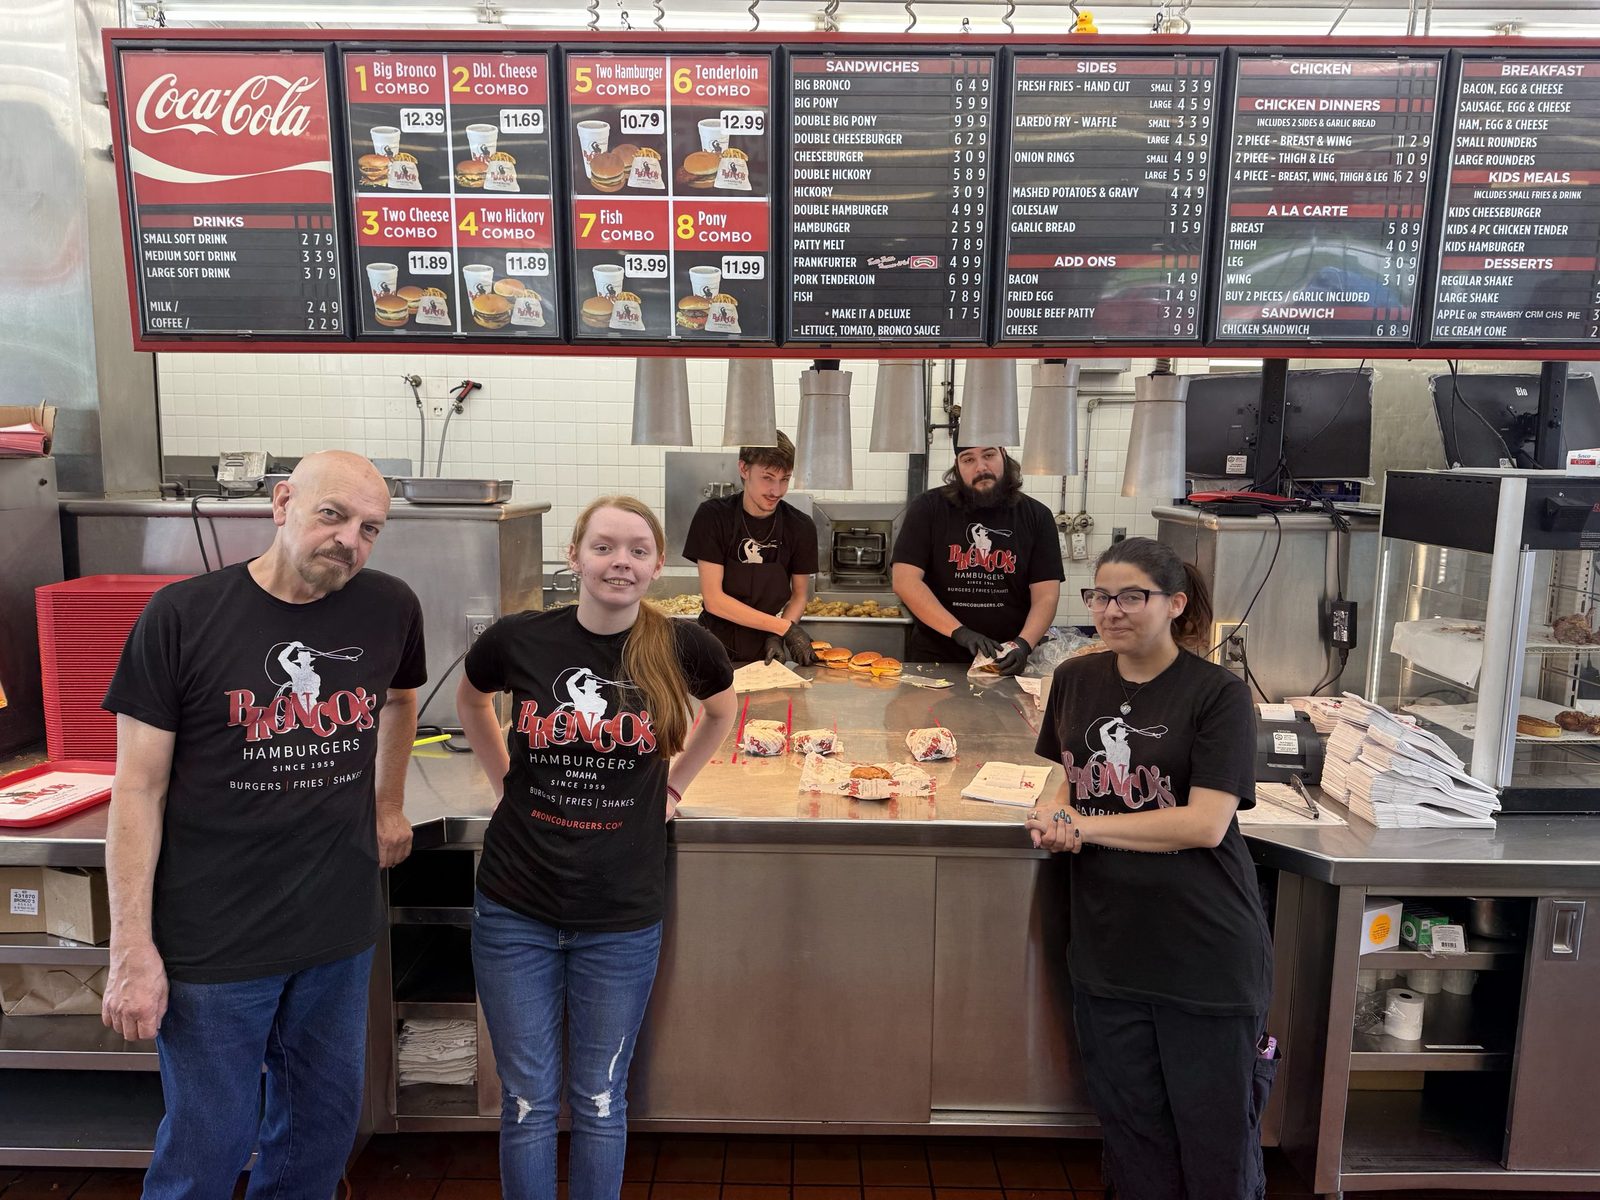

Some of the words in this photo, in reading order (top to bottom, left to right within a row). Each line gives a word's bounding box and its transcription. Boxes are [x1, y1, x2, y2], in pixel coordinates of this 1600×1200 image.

[374, 62, 392, 79] Big
[396, 63, 436, 78] Bronco
[473, 63, 496, 78] Dbl.
[500, 63, 537, 78] Cheese
[826, 61, 919, 72] SANDWICHES
[1077, 62, 1116, 73] SIDES
[1290, 64, 1351, 74] CHICKEN
[1502, 65, 1584, 76] BREAKFAST
[596, 64, 613, 78] Two
[615, 64, 662, 81] Hamburger
[696, 65, 758, 79] Tenderloin
[355, 66, 367, 92] 1
[452, 67, 470, 92] 2
[575, 68, 592, 92] 5
[674, 68, 692, 93] 6
[375, 83, 429, 94] COMBO
[475, 84, 528, 95] COMBO
[596, 85, 650, 95] COMBO
[795, 80, 810, 90] BIG
[814, 80, 850, 90] BRONCO
[1151, 84, 1172, 92] SMALL
[696, 85, 750, 96] COMBO
[136, 73, 320, 136] Coca-Cola
[795, 98, 810, 108] BIG
[814, 98, 838, 108] PONY
[1150, 100, 1171, 108] LARGE
[1255, 100, 1315, 111] CHICKEN
[1320, 100, 1380, 111] DINNERS
[404, 112, 443, 126] 12.39
[504, 113, 540, 127] 11.69
[622, 113, 659, 128] 10.79
[723, 116, 763, 130] 12.99
[1149, 119, 1170, 128] SMALL
[795, 133, 830, 144] DOUBLE
[833, 133, 902, 144] CHEESEBURGER
[1147, 136, 1169, 144] LARGE
[1457, 137, 1485, 147] SMALL
[1488, 137, 1537, 147] ROUNDERS
[795, 151, 863, 162] CHEESEBURGER
[1015, 152, 1044, 162] ONION
[1047, 152, 1074, 162] RINGS
[1147, 155, 1168, 163] SMALL
[1455, 155, 1483, 165] LARGE
[1486, 155, 1535, 165] ROUNDERS
[1145, 171, 1167, 179] LARGE
[1489, 172, 1520, 182] KIDS
[1524, 172, 1570, 182] MEALS
[794, 187, 833, 197] HICKORY
[1013, 187, 1049, 197] MASHED
[1053, 187, 1096, 197] POTATOES
[1099, 187, 1106, 197] &
[1109, 187, 1139, 197] GRAVY
[382, 207, 405, 222] Two
[410, 207, 449, 222] Cheese
[794, 205, 829, 215] DOUBLE
[832, 205, 888, 215] HAMBURGER
[1012, 205, 1058, 215] COLESLAW
[1268, 206, 1277, 216] A
[1282, 206, 1299, 216] LA
[1303, 206, 1348, 216] CARTE
[1449, 207, 1470, 217] KIDS
[1473, 207, 1541, 217] CHEESEBURGER
[194, 217, 244, 226] DRINKS
[481, 208, 502, 222] Two
[506, 209, 544, 225] Hickory
[601, 210, 622, 224] Fish
[699, 211, 726, 227] Pony
[362, 211, 379, 235] 3
[459, 212, 478, 235] 4
[580, 214, 597, 237] 7
[677, 215, 694, 239] 8
[794, 222, 850, 232] HAMBURGER
[1012, 222, 1042, 232] GARLIC
[1045, 222, 1075, 232] BREAD
[1231, 223, 1264, 233] BREAST
[384, 227, 437, 238] COMBO
[482, 228, 535, 239] COMBO
[601, 230, 654, 241] COMBO
[699, 232, 751, 242] COMBO
[144, 234, 171, 244] SMALL
[175, 234, 195, 244] SOFT
[199, 234, 227, 244] DRINK
[794, 240, 820, 250] PATTY
[824, 240, 844, 250] MELT
[1230, 240, 1256, 250] THIGH
[145, 251, 181, 261] MEDIUM
[184, 252, 205, 261] SOFT
[208, 252, 236, 261] DRINK
[1055, 256, 1083, 266] ADD
[1087, 256, 1116, 266] ONS
[410, 256, 447, 269] 11.89
[508, 257, 545, 270] 11.89
[627, 258, 666, 272] 13.99
[794, 257, 856, 267] FRANKFURTER
[1228, 257, 1243, 266] LEG
[1485, 259, 1553, 268] DESSERTS
[725, 261, 760, 274] 11.99
[147, 268, 175, 278] LARGE
[178, 268, 198, 278] SOFT
[202, 268, 230, 278] DRINK
[794, 275, 818, 284] PORK
[821, 275, 874, 284] TENDERLOIN
[1009, 274, 1038, 284] BACON
[1227, 274, 1251, 284] WING
[1442, 276, 1481, 285] REGULAR
[1484, 276, 1513, 285] SHAKE
[794, 292, 812, 301] FISH
[1008, 291, 1033, 301] FRIED
[1036, 291, 1053, 301] EGG
[1440, 293, 1467, 302] LARGE
[1470, 293, 1499, 302] SHAKE
[150, 302, 171, 311] MILK
[1007, 308, 1041, 318] DOUBLE
[1044, 308, 1065, 318] BEEF
[1068, 308, 1094, 318] PATTY
[1262, 308, 1334, 318] SANDWICH
[152, 318, 182, 327] COFFEE
[1006, 325, 1037, 334] CHEESE
[1222, 324, 1258, 334] CHICKEN
[1262, 324, 1309, 334] SANDWICH
[1436, 326, 1449, 336] ICE
[1452, 326, 1481, 336] CREAM
[1484, 326, 1507, 336] CONE
[224, 687, 376, 742] BRONCO'S
[517, 700, 656, 755] BRONCO'S
[244, 739, 360, 760] HAMBURGERS
[273, 764, 306, 772] SINCE
[312, 760, 335, 768] 1959
[530, 754, 635, 769] HAMBURGERS
[566, 770, 597, 780] OMAHA
[230, 781, 281, 790] BURGERS
[294, 779, 323, 788] FRIES
[551, 780, 578, 788] SINCE
[566, 797, 592, 806] FRIES
[602, 799, 634, 808] SHAKES
